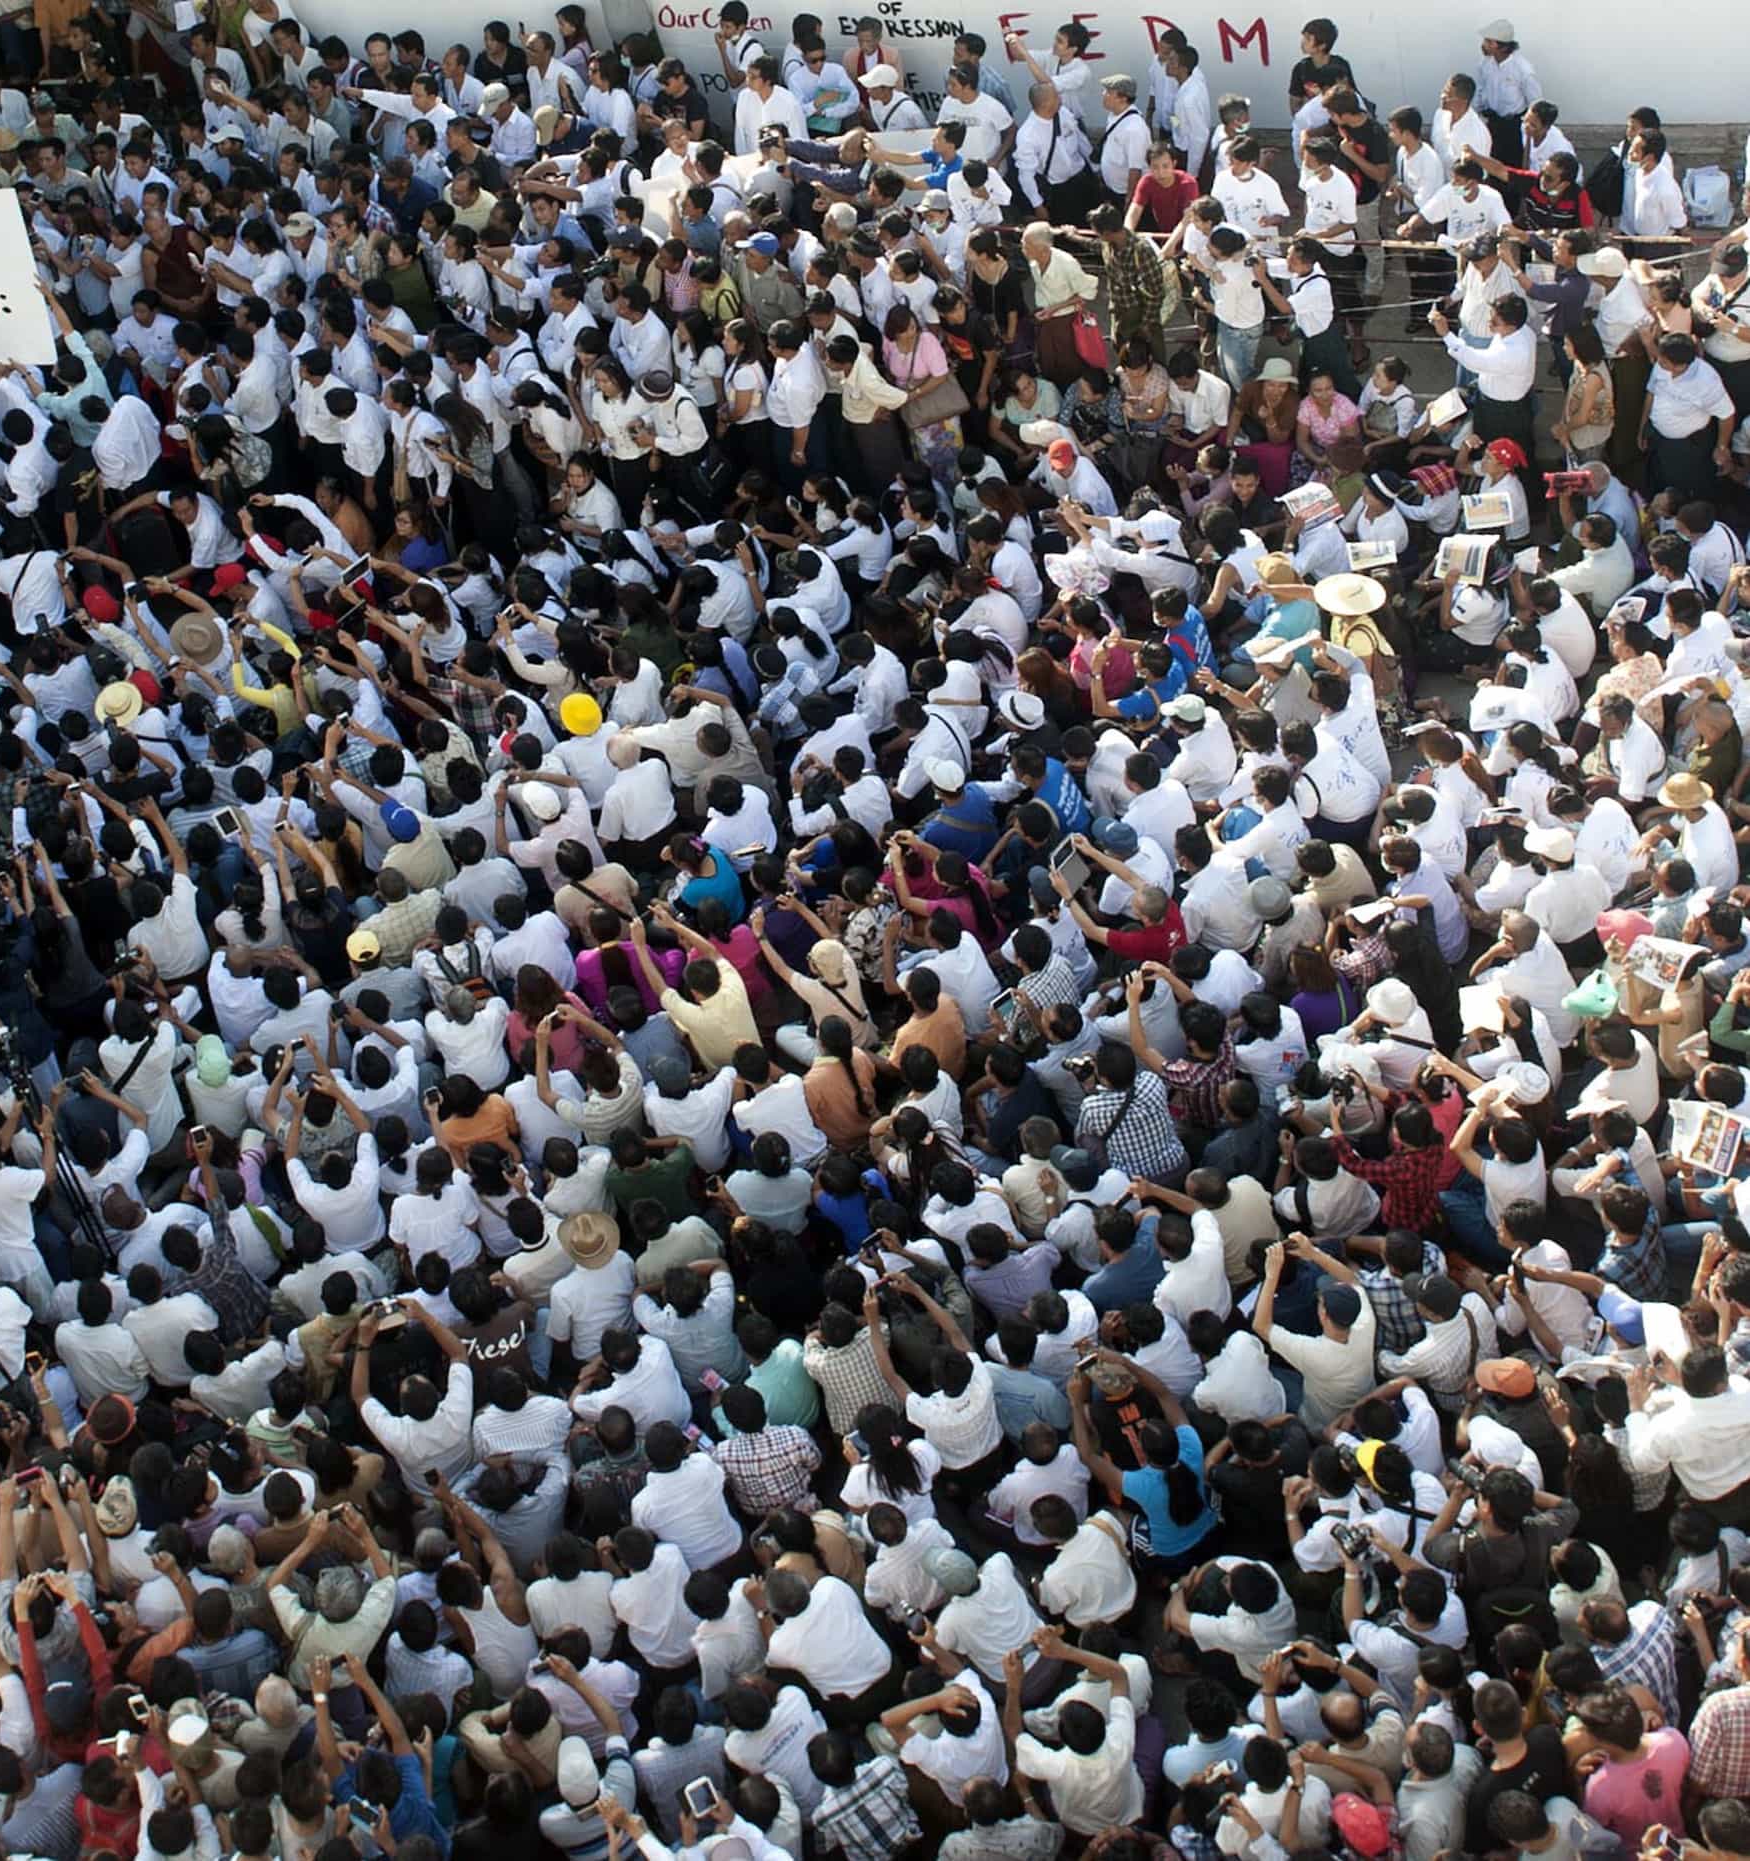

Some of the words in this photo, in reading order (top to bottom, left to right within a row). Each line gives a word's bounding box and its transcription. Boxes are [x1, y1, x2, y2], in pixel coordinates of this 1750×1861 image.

[657, 4, 699, 28] Our
[877, 1, 902, 16] OF
[838, 16, 965, 38] EXRESSION
